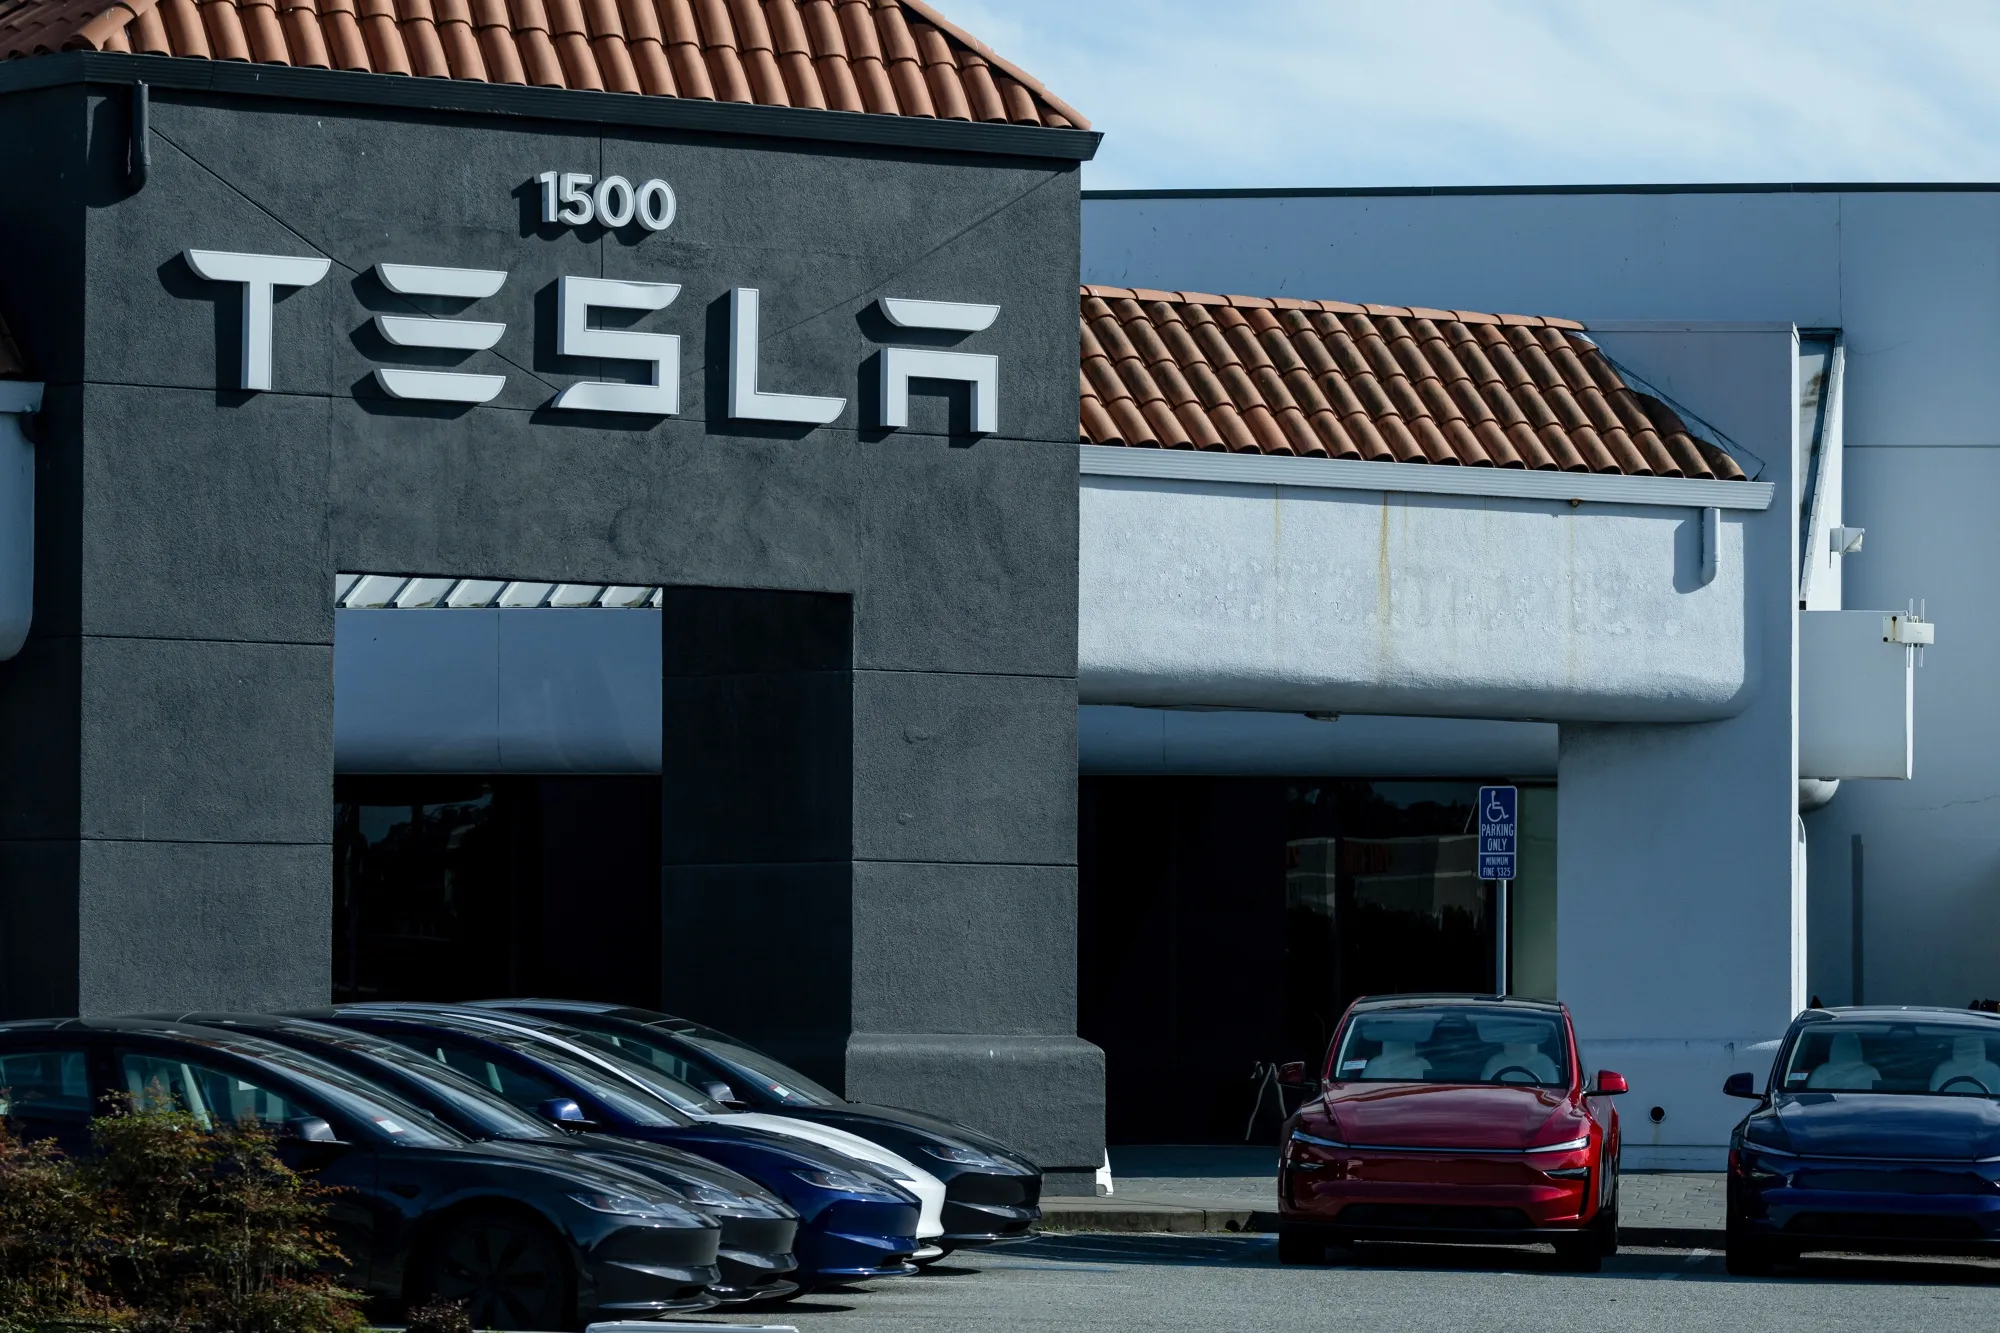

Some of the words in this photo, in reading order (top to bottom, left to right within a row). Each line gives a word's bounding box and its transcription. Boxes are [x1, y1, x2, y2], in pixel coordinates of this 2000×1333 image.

[536, 171, 677, 232] 1500
[184, 248, 1001, 434] TESLA
[1481, 823, 1514, 837] PARKING
[1487, 838, 1507, 851] ONLY
[1485, 856, 1509, 866] MINIMUM
[1483, 867, 1495, 877] FINE
